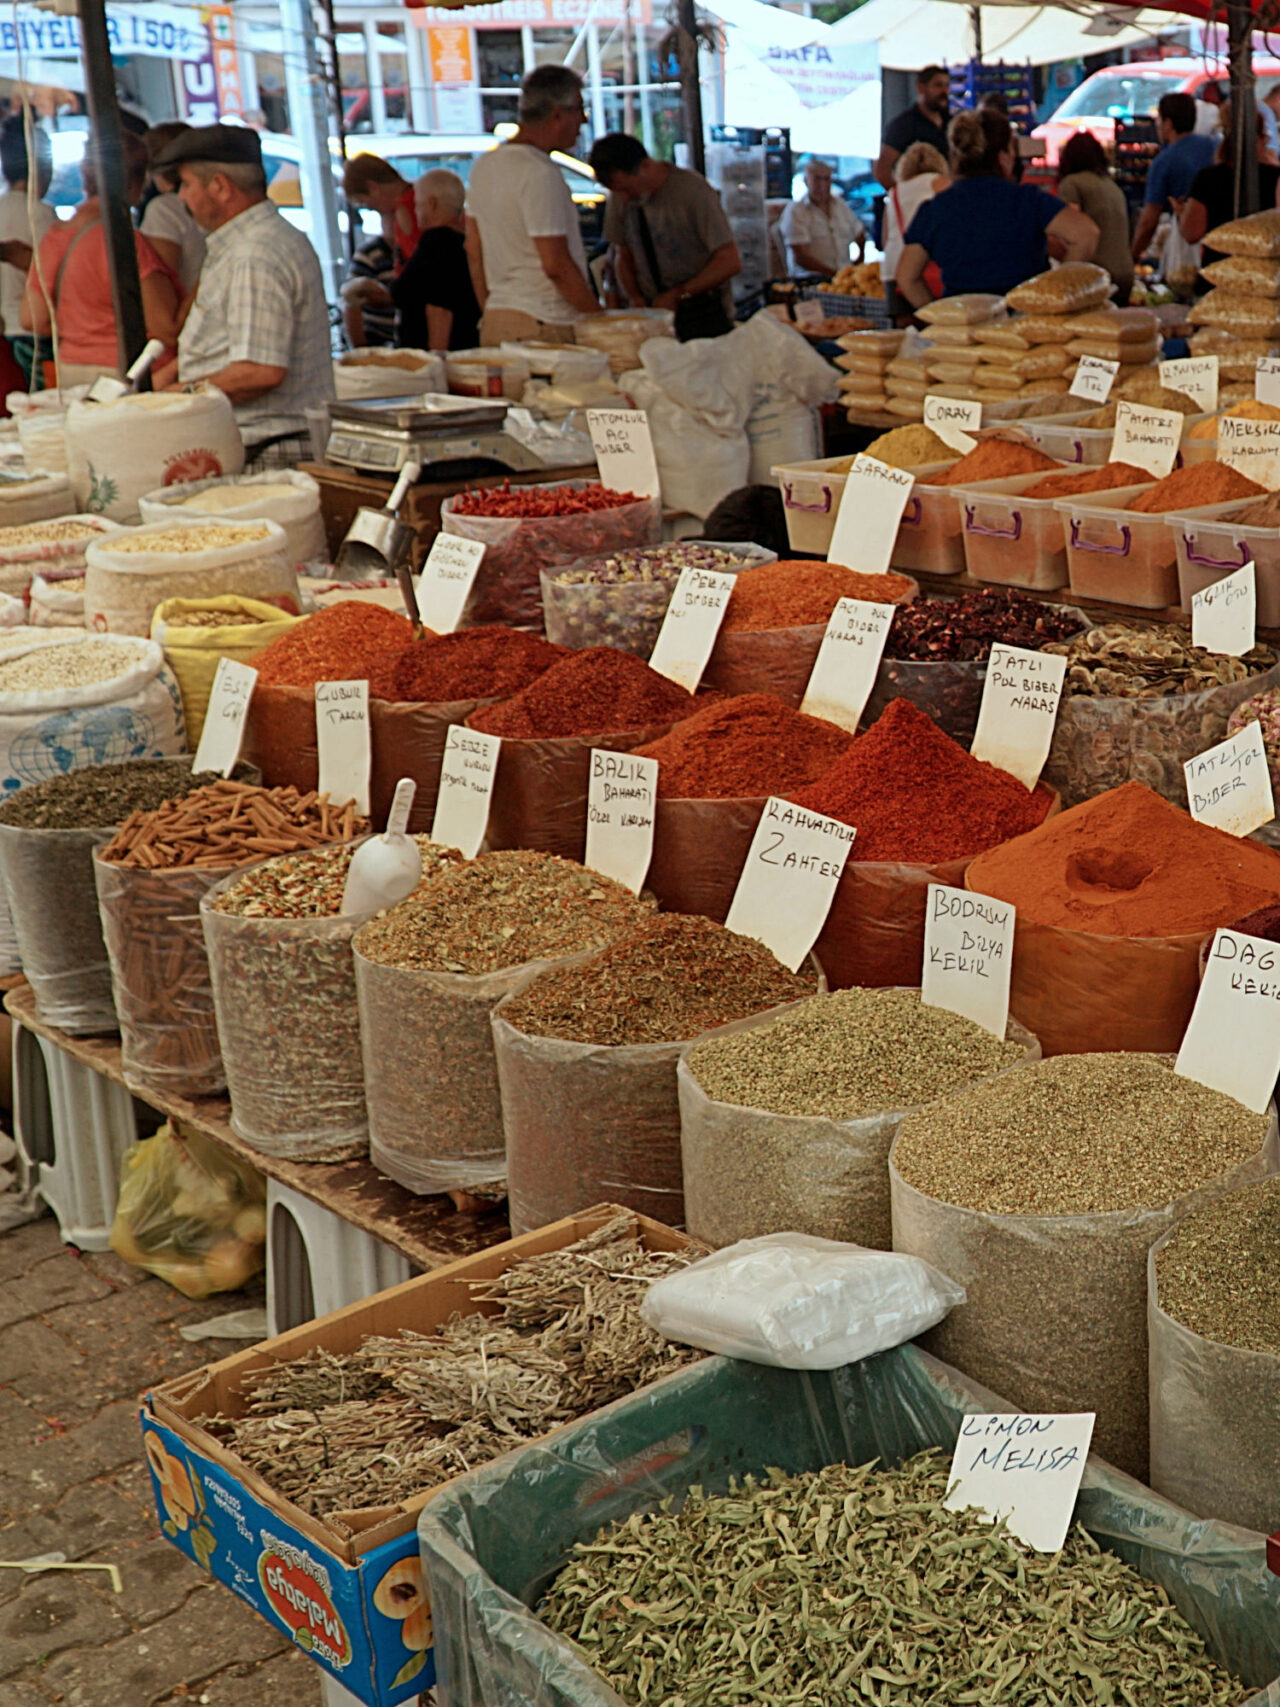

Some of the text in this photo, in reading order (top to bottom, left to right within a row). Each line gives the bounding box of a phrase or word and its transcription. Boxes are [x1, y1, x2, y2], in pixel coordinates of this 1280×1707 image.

[593, 754, 648, 782] BALIK
[934, 888, 1009, 932] BODRUM
[265, 1566, 342, 1646] Malatya
